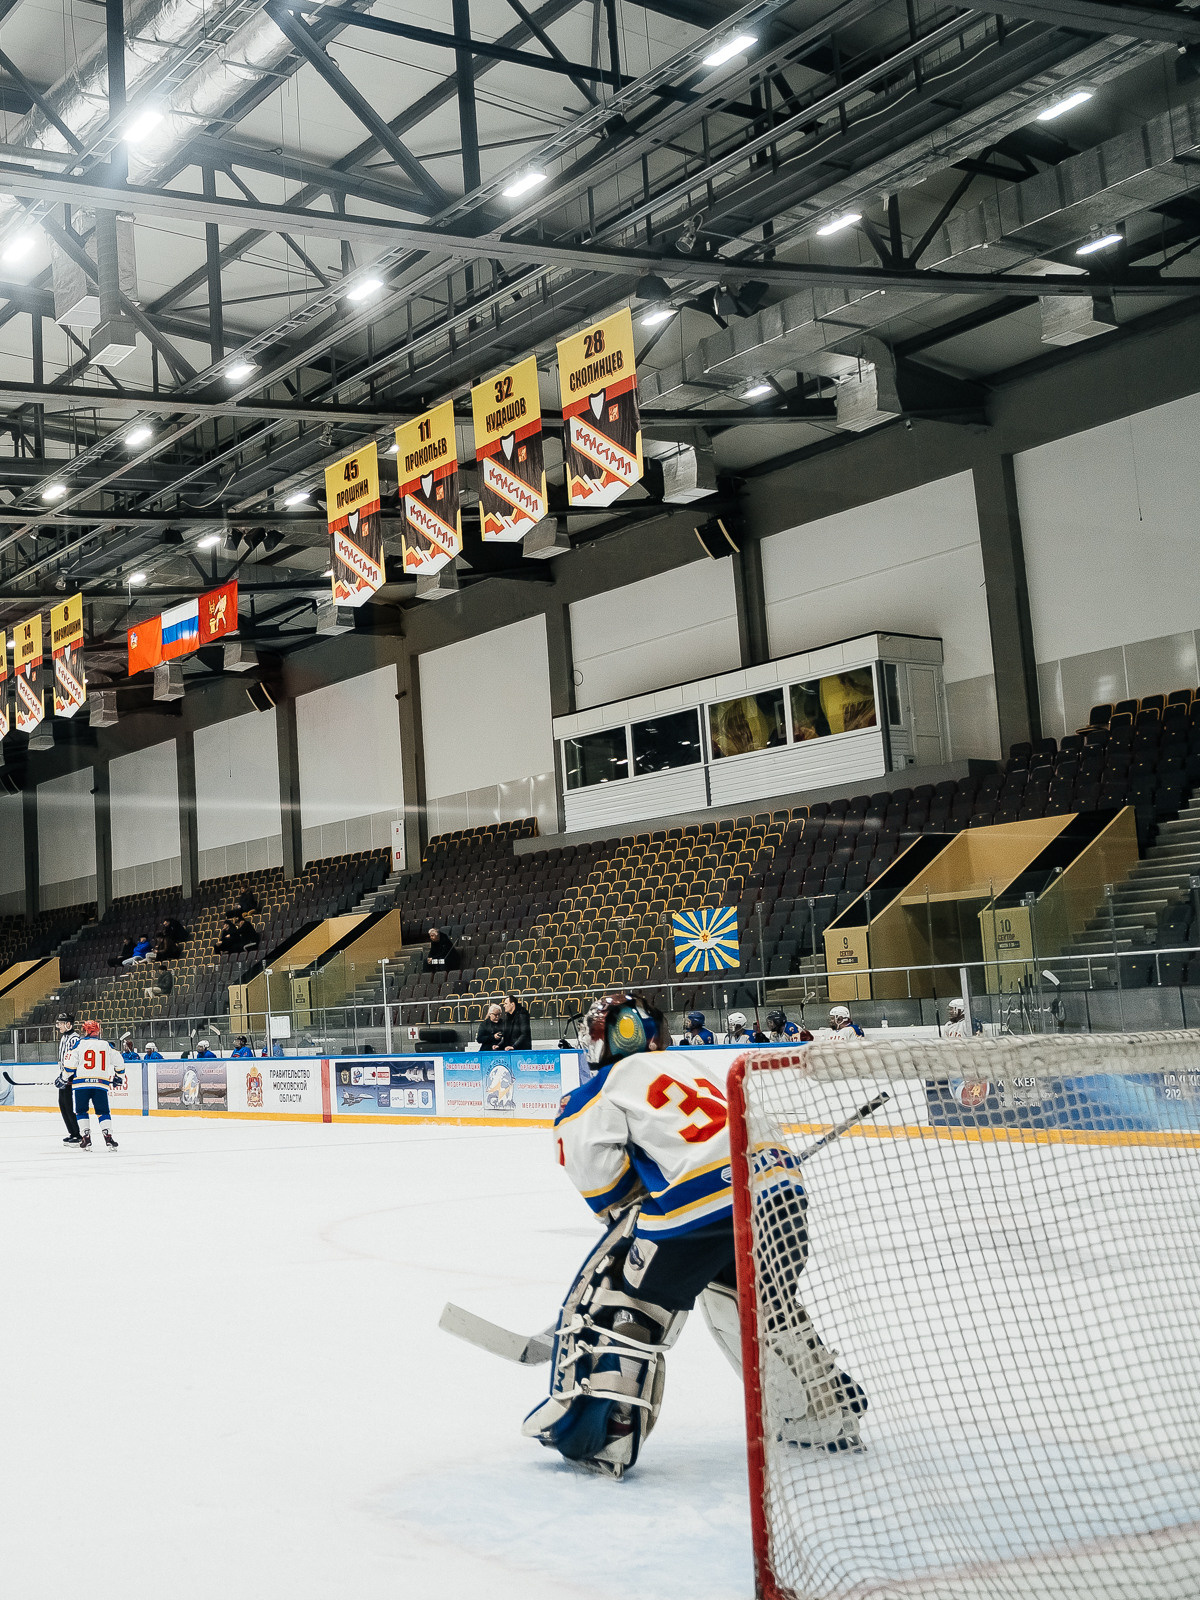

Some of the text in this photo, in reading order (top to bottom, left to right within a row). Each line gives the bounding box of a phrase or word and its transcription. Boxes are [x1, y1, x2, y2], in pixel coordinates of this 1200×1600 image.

[583, 329, 606, 360] 28
[569, 350, 625, 393] СКОПИНЦЕВ
[494, 376, 514, 403] 32
[485, 397, 527, 434] КУДАШОВ
[417, 418, 432, 441] 11
[405, 437, 448, 473] ПРОКОПЬЕВ
[575, 427, 632, 476] КРИСТАЛЛ
[343, 459, 360, 481] 45
[336, 478, 369, 509] ПРОШКИН
[489, 467, 538, 512] КРИСТАЛЛ
[410, 504, 454, 549] КРИСТАЛЛ
[338, 540, 378, 582] КРИСТАЛЛ
[63, 605, 69, 621] 8
[24, 624, 31, 640] 14
[1000, 919, 1011, 933] 10
[843, 936, 849, 949] 9
[84, 1049, 106, 1071] 91
[520, 1064, 555, 1072] ОРГАНИЗАЦИЯ
[269, 1069, 311, 1079] ПРАВИТЕЛЬСТВО
[997, 1077, 1036, 1087] ХККЕЯ
[272, 1080, 308, 1091] МОСКОВСКОЙ
[1165, 1088, 1182, 1100] 202
[278, 1093, 302, 1103] ОБЛАСТИ
